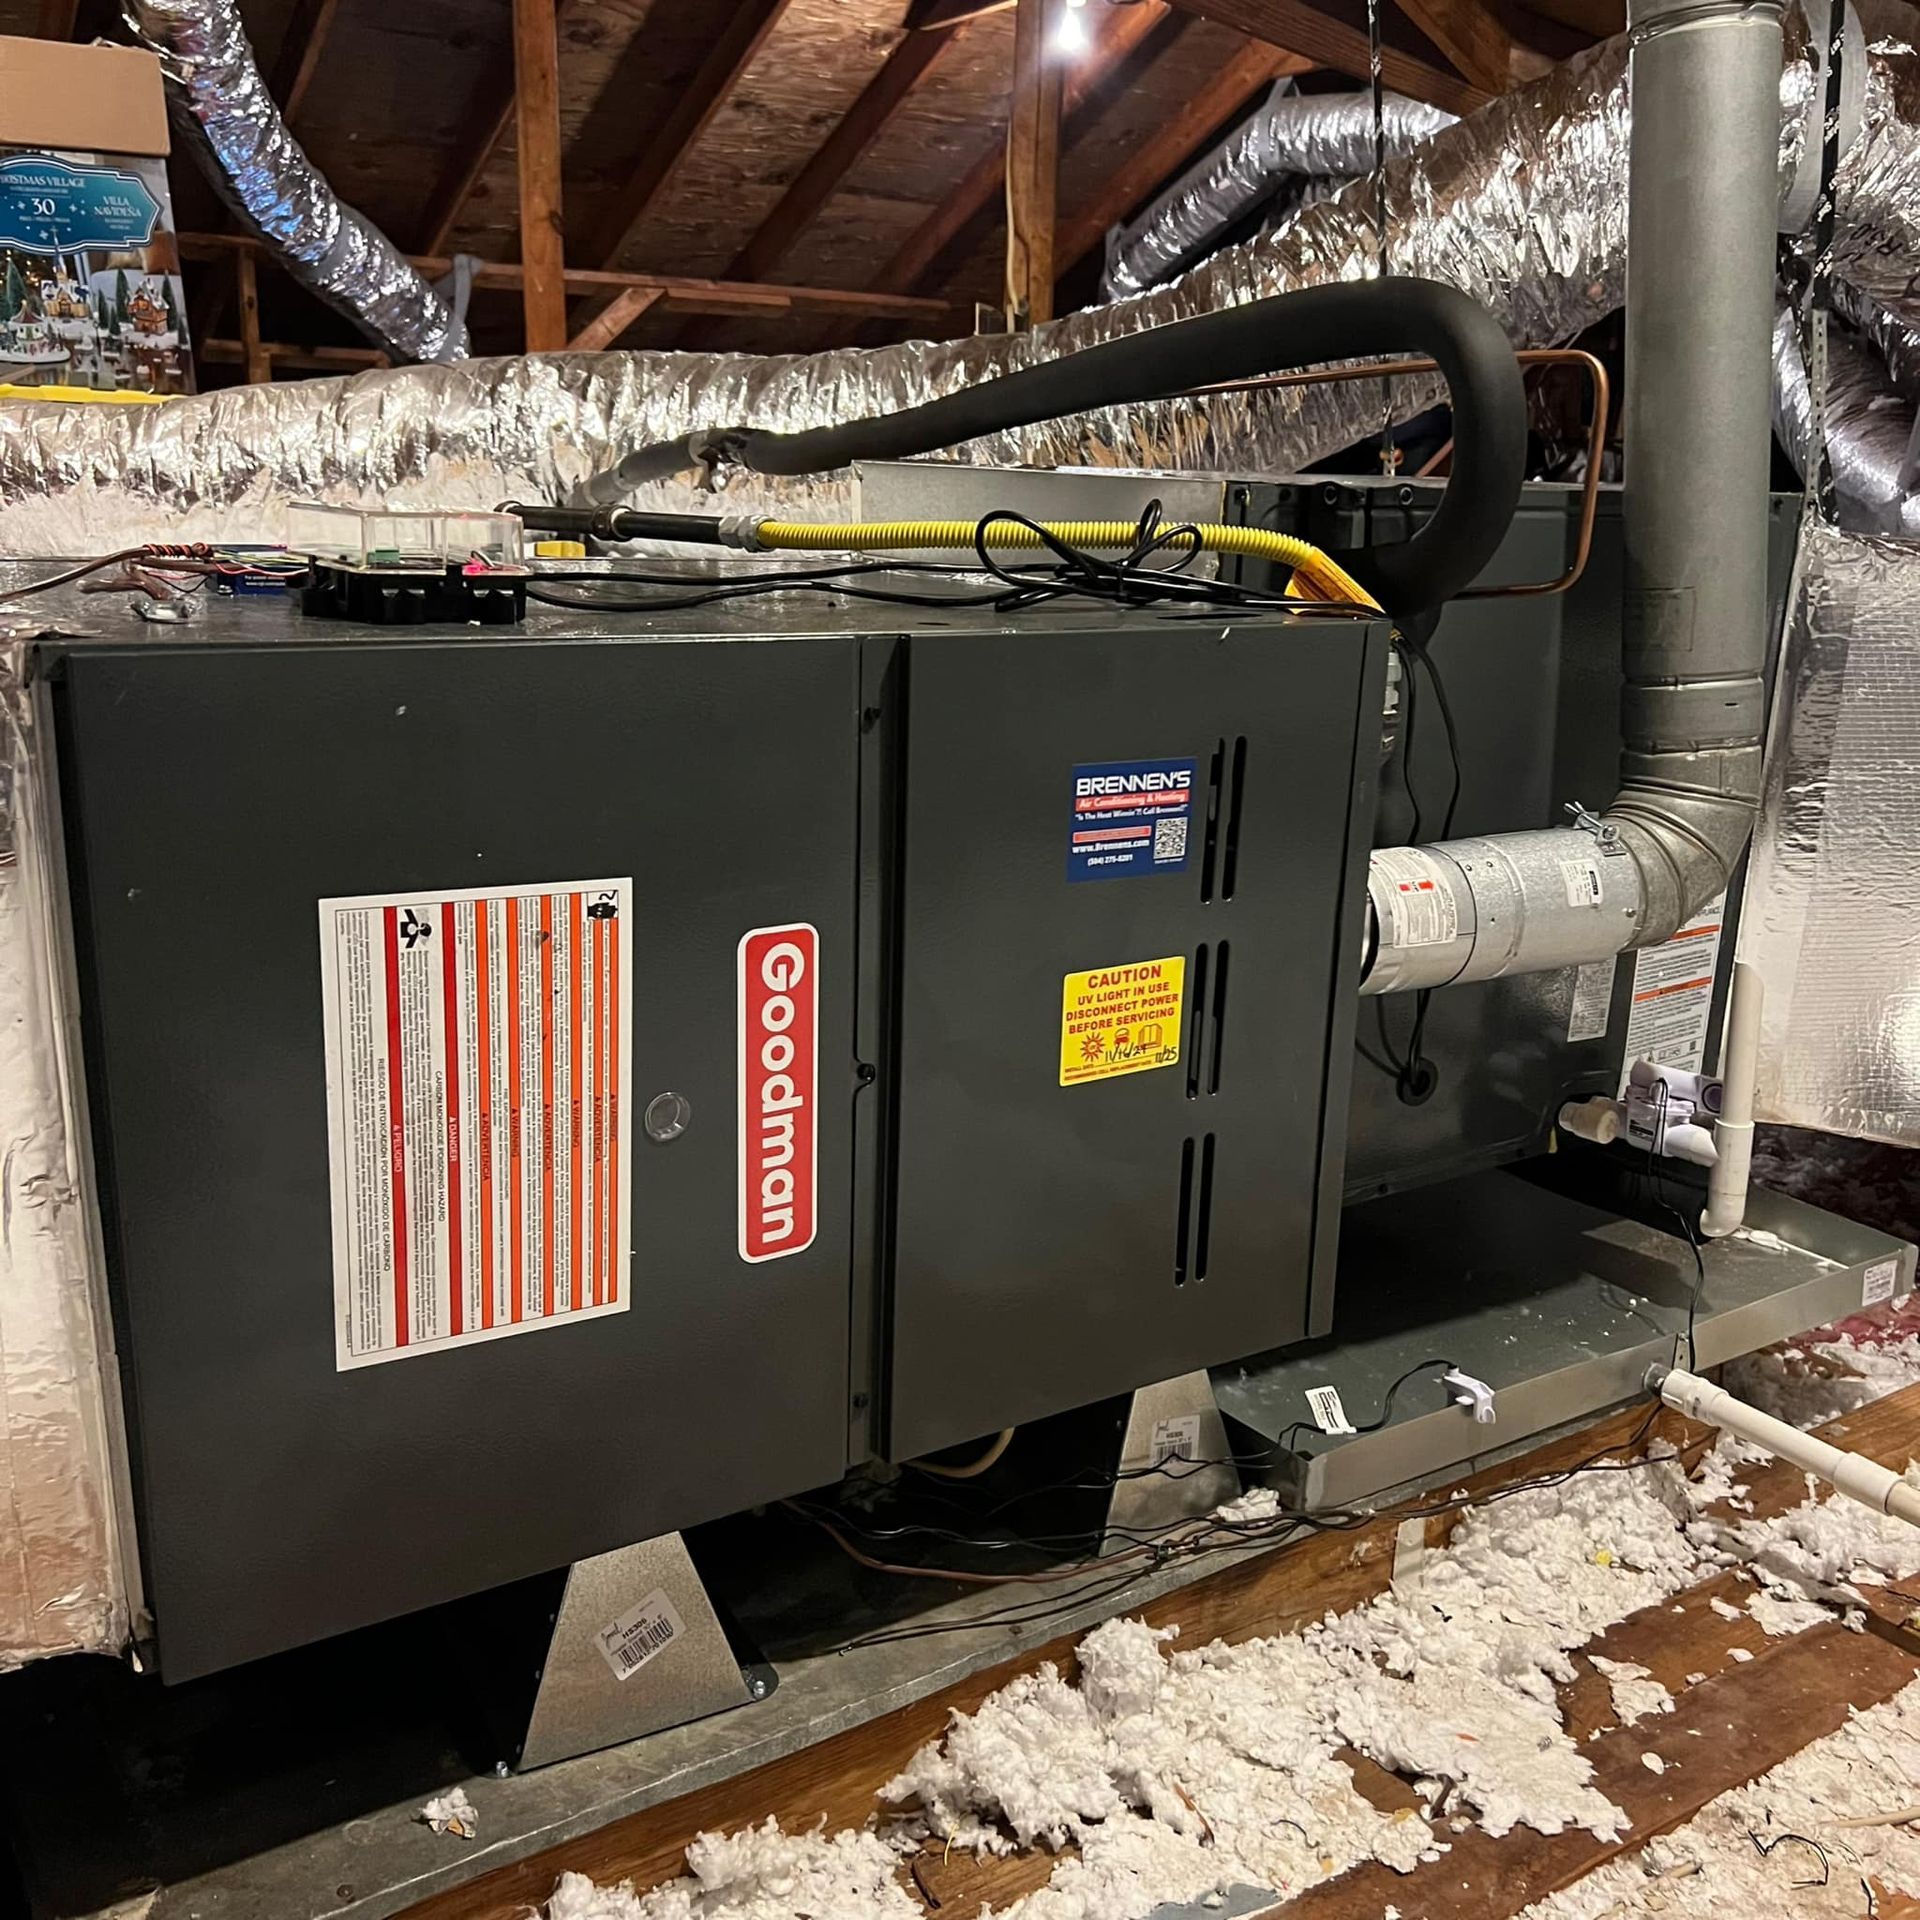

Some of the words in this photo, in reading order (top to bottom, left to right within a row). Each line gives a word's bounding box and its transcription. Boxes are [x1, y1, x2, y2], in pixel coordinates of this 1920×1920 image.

[46, 176, 86, 188] VILLAGE
[32, 198, 55, 215] 30
[102, 195, 130, 206] VILLA
[1076, 770, 1191, 796] BRENNEN'S
[1080, 798, 1092, 808] Air
[1094, 794, 1146, 806] Conditioning
[1154, 790, 1186, 802] Heating
[1087, 964, 1162, 989] CAUTION
[1066, 1000, 1139, 1022] DISCONNECT
[1141, 994, 1179, 1008] POWER
[1077, 994, 1095, 1006] UV
[1096, 988, 1130, 1003] LIGHT
[1133, 986, 1145, 996] IN
[1148, 982, 1170, 994] USE
[1068, 1018, 1114, 1034] BEFORE
[1116, 1007, 1176, 1026] SERVICING
[378, 1058, 386, 1089] RIESGO
[435, 1071, 443, 1103] CARBON
[379, 1091, 386, 1102] DE
[761, 942, 805, 1244] Goodman
[436, 1105, 444, 1146] MONOXIDE
[511, 1115, 519, 1158] WARNING
[594, 1104, 602, 1164] ADVERTENCIA
[394, 1132, 402, 1172] PELIGRO
[449, 1124, 457, 1162] DANGER
[482, 1120, 490, 1182] ADVERTENCIA
[544, 1112, 552, 1172] ADVERTENCIA
[380, 1160, 388, 1177] POR
[437, 1147, 445, 1190] POISONING
[381, 1179, 390, 1220] MONÓXIDO
[438, 1191, 446, 1222] HAZARD
[382, 1221, 390, 1232] DE
[382, 1233, 390, 1272] CARBONO
